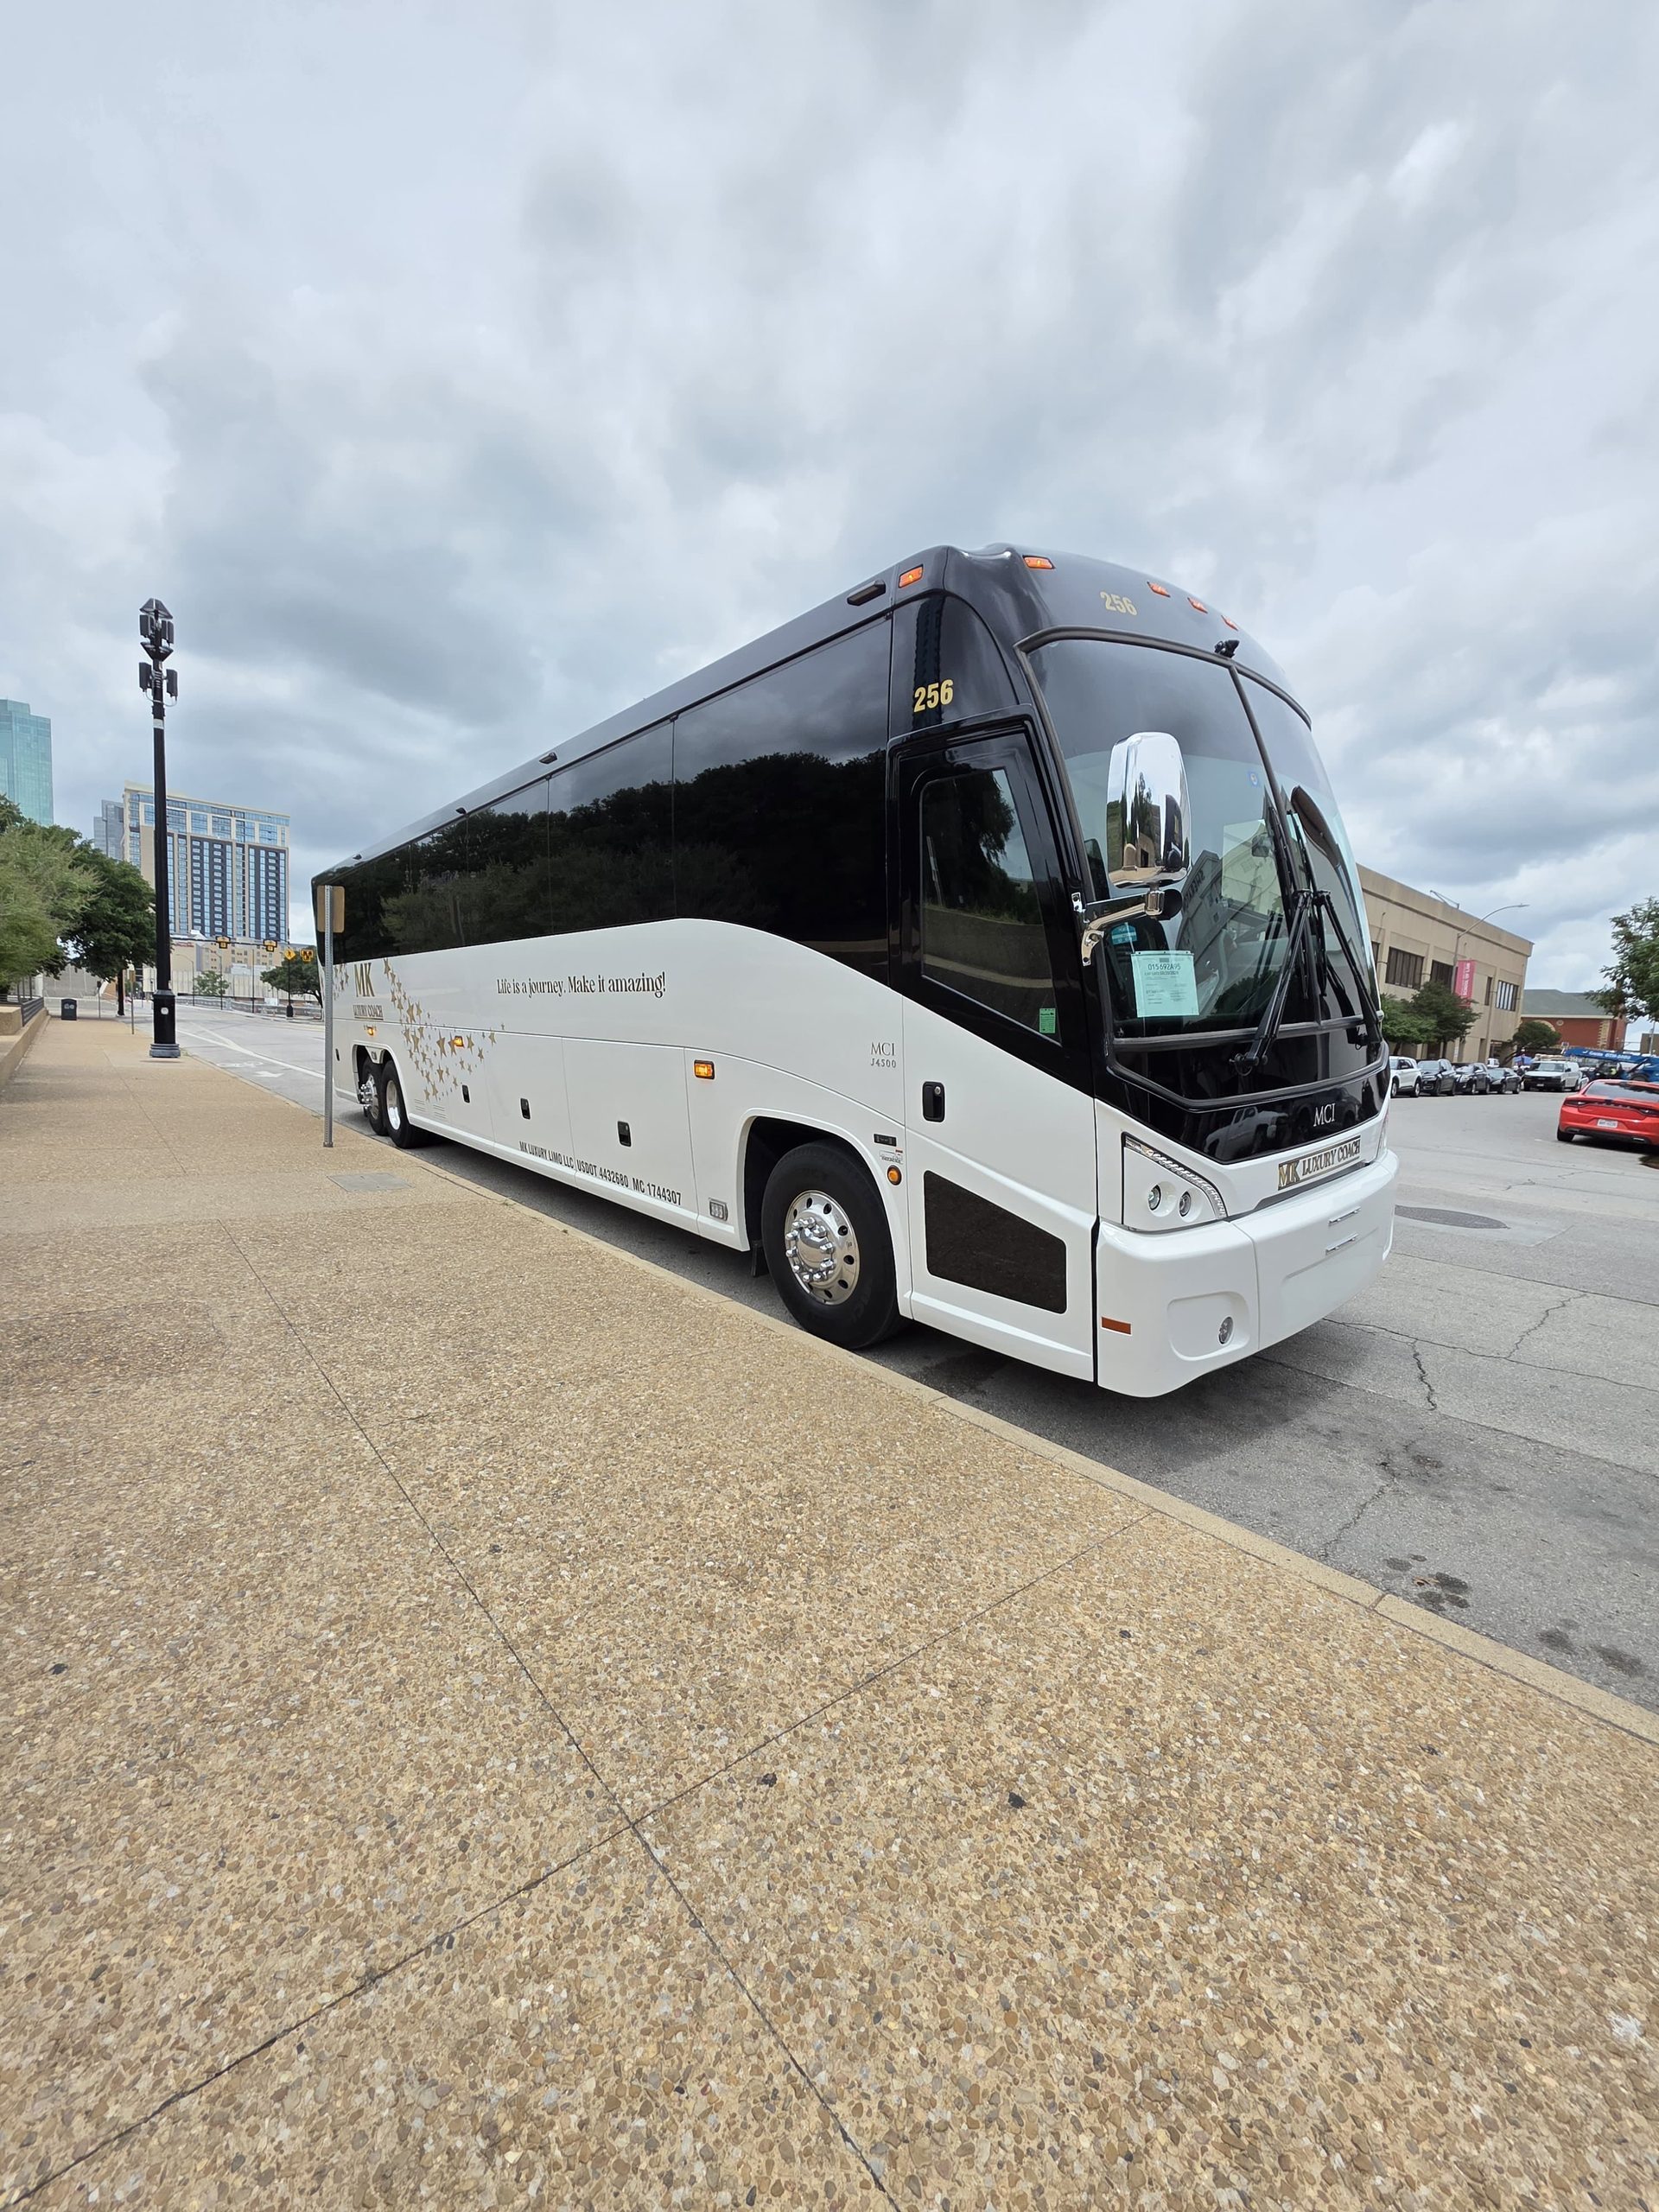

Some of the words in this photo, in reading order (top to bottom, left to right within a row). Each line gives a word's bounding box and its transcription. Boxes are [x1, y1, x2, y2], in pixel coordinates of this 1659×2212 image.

[1099, 591, 1138, 616] 256
[913, 679, 954, 713] 256
[354, 963, 375, 997] MK
[496, 978, 512, 994] Life
[512, 979, 520, 994] is
[521, 983, 527, 994] a
[528, 978, 566, 998] journey.
[568, 975, 595, 993] Make
[598, 974, 606, 993] it
[608, 971, 666, 998] amazing!
[367, 1004, 384, 1018] COACH
[870, 1041, 895, 1056] MCI
[870, 1058, 897, 1068] J4500
[1313, 1103, 1336, 1127] MCI
[519, 1141, 528, 1152] MK
[528, 1143, 547, 1160] LUXURY
[548, 1150, 563, 1165] LIMO
[563, 1155, 574, 1169] LLC
[576, 1159, 597, 1177] USDOT
[599, 1166, 629, 1188] 4432680
[632, 1178, 645, 1193] MC
[647, 1183, 682, 1205] 1744307
[1278, 1159, 1300, 1187] MK
[1301, 1149, 1337, 1176] LUXURY
[1338, 1139, 1361, 1163] COACH
